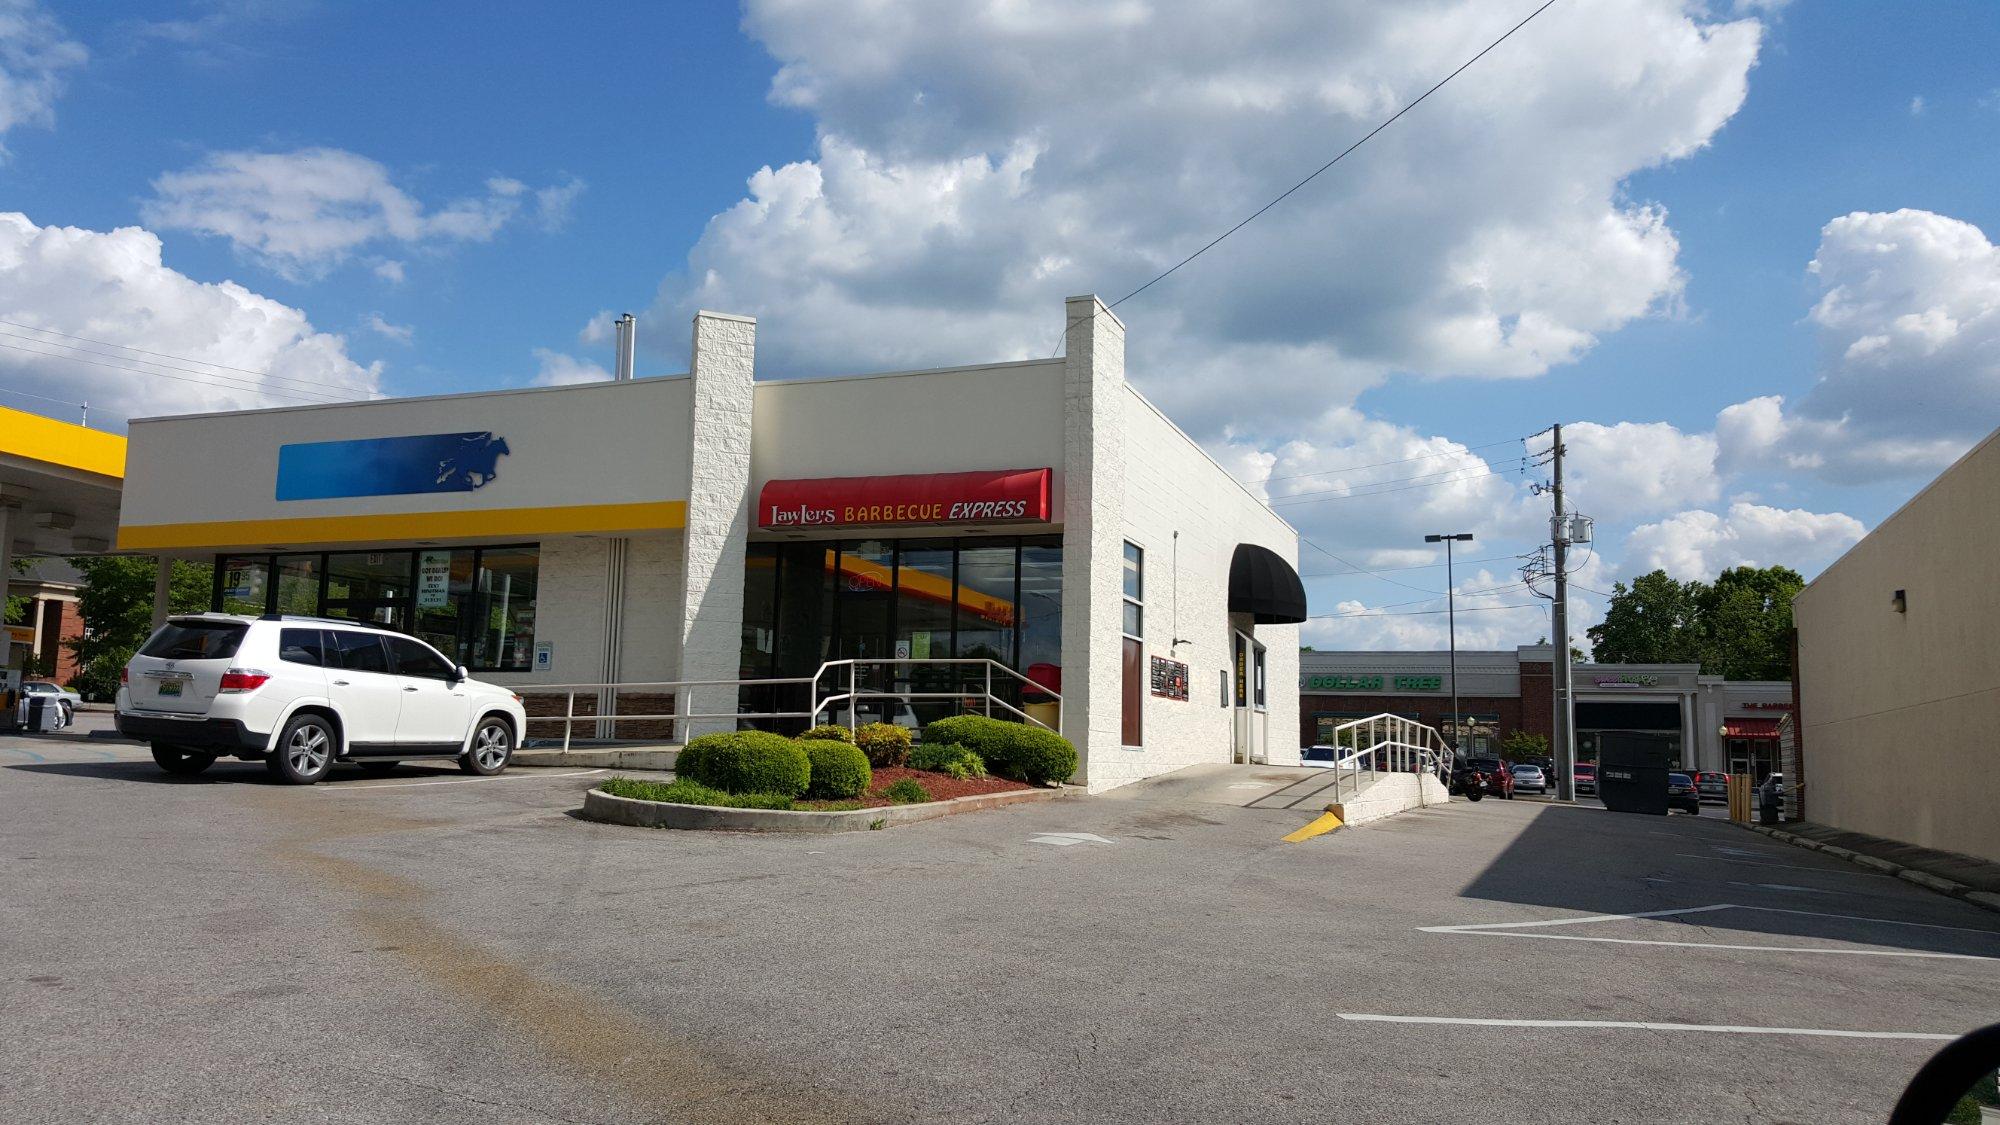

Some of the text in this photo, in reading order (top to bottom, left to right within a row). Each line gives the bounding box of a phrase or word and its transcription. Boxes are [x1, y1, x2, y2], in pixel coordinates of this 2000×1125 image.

[844, 503, 942, 522] BARBECUE
[948, 500, 1027, 520] EXPRESS
[849, 577, 882, 589] OPEN
[1308, 675, 1442, 690] DOLLAR TREE
